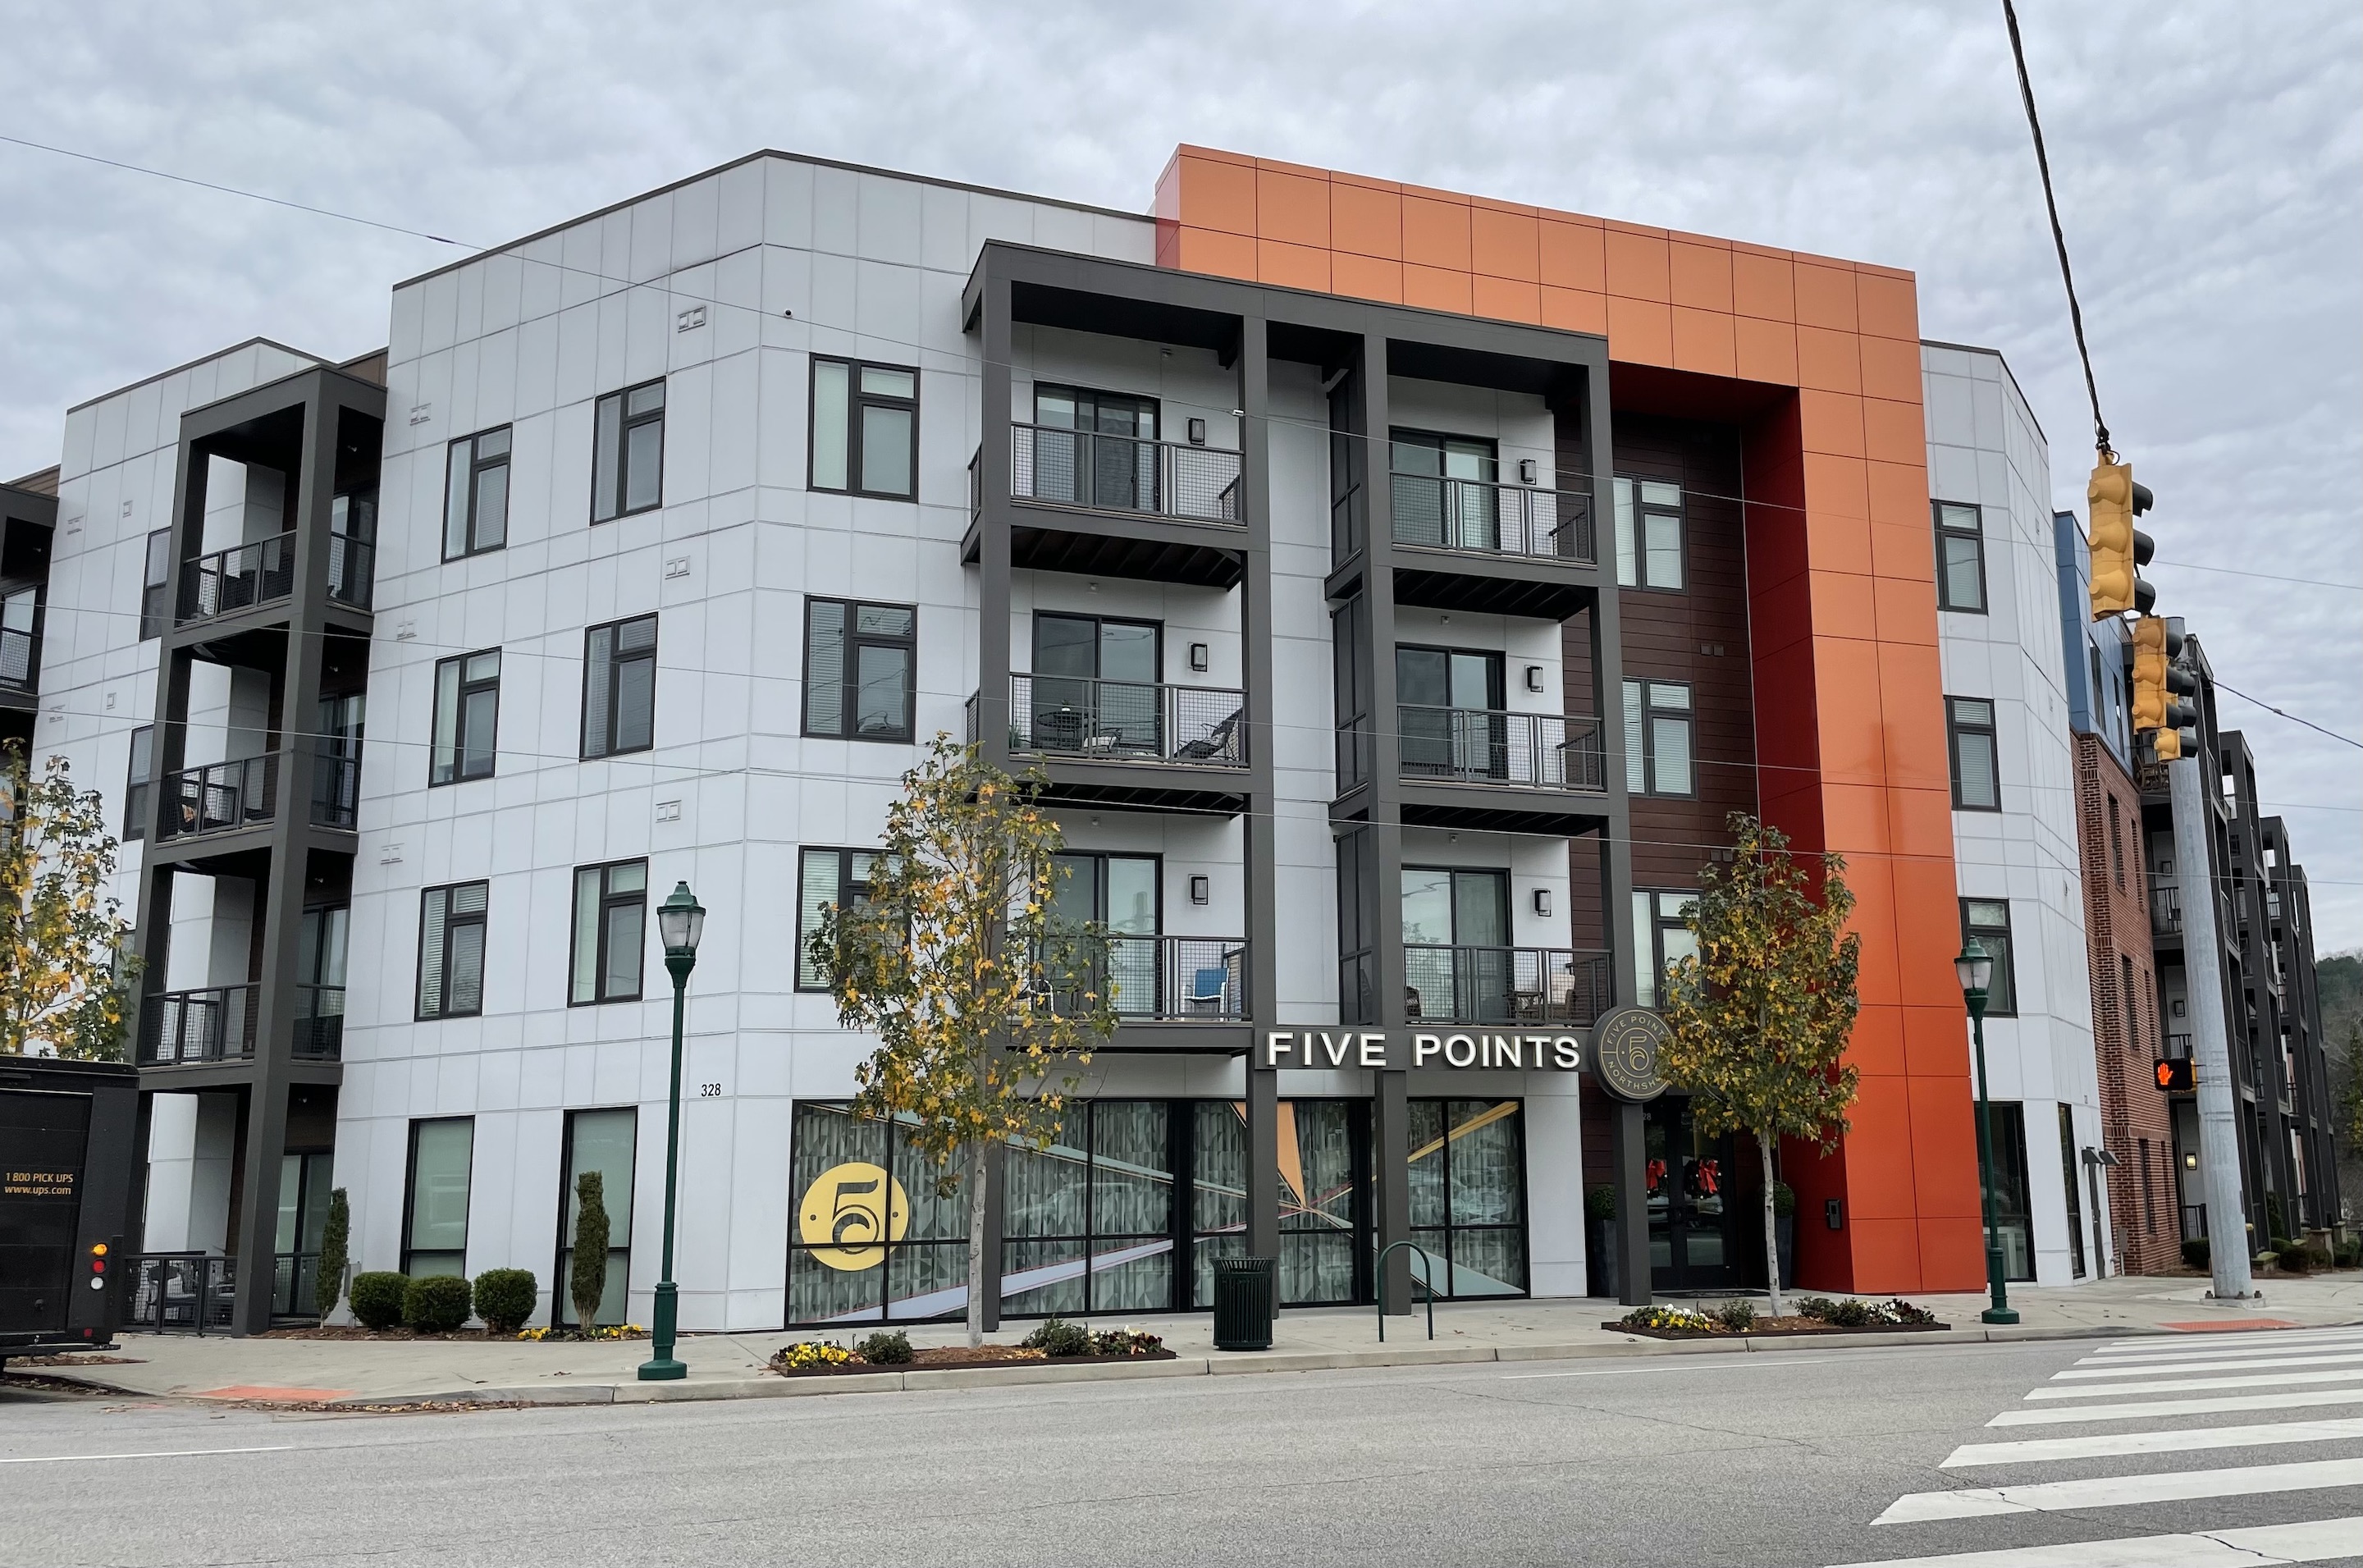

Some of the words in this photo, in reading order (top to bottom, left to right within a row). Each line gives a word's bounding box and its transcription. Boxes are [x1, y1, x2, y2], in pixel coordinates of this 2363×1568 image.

[1607, 1019, 1627, 1045] FIVE
[1630, 1016, 1665, 1036] POINT
[1266, 1031, 1387, 1067] FIVE
[1412, 1033, 1580, 1068] POINTS
[1629, 1035, 1649, 1072] 5
[701, 1082, 721, 1097] 328
[4, 1186, 71, 1196] www.ups.com
[6, 1172, 11, 1182] 1
[12, 1173, 30, 1182] 800
[33, 1173, 54, 1182] PICK
[56, 1173, 74, 1183] UPS
[831, 1178, 880, 1255] 5
